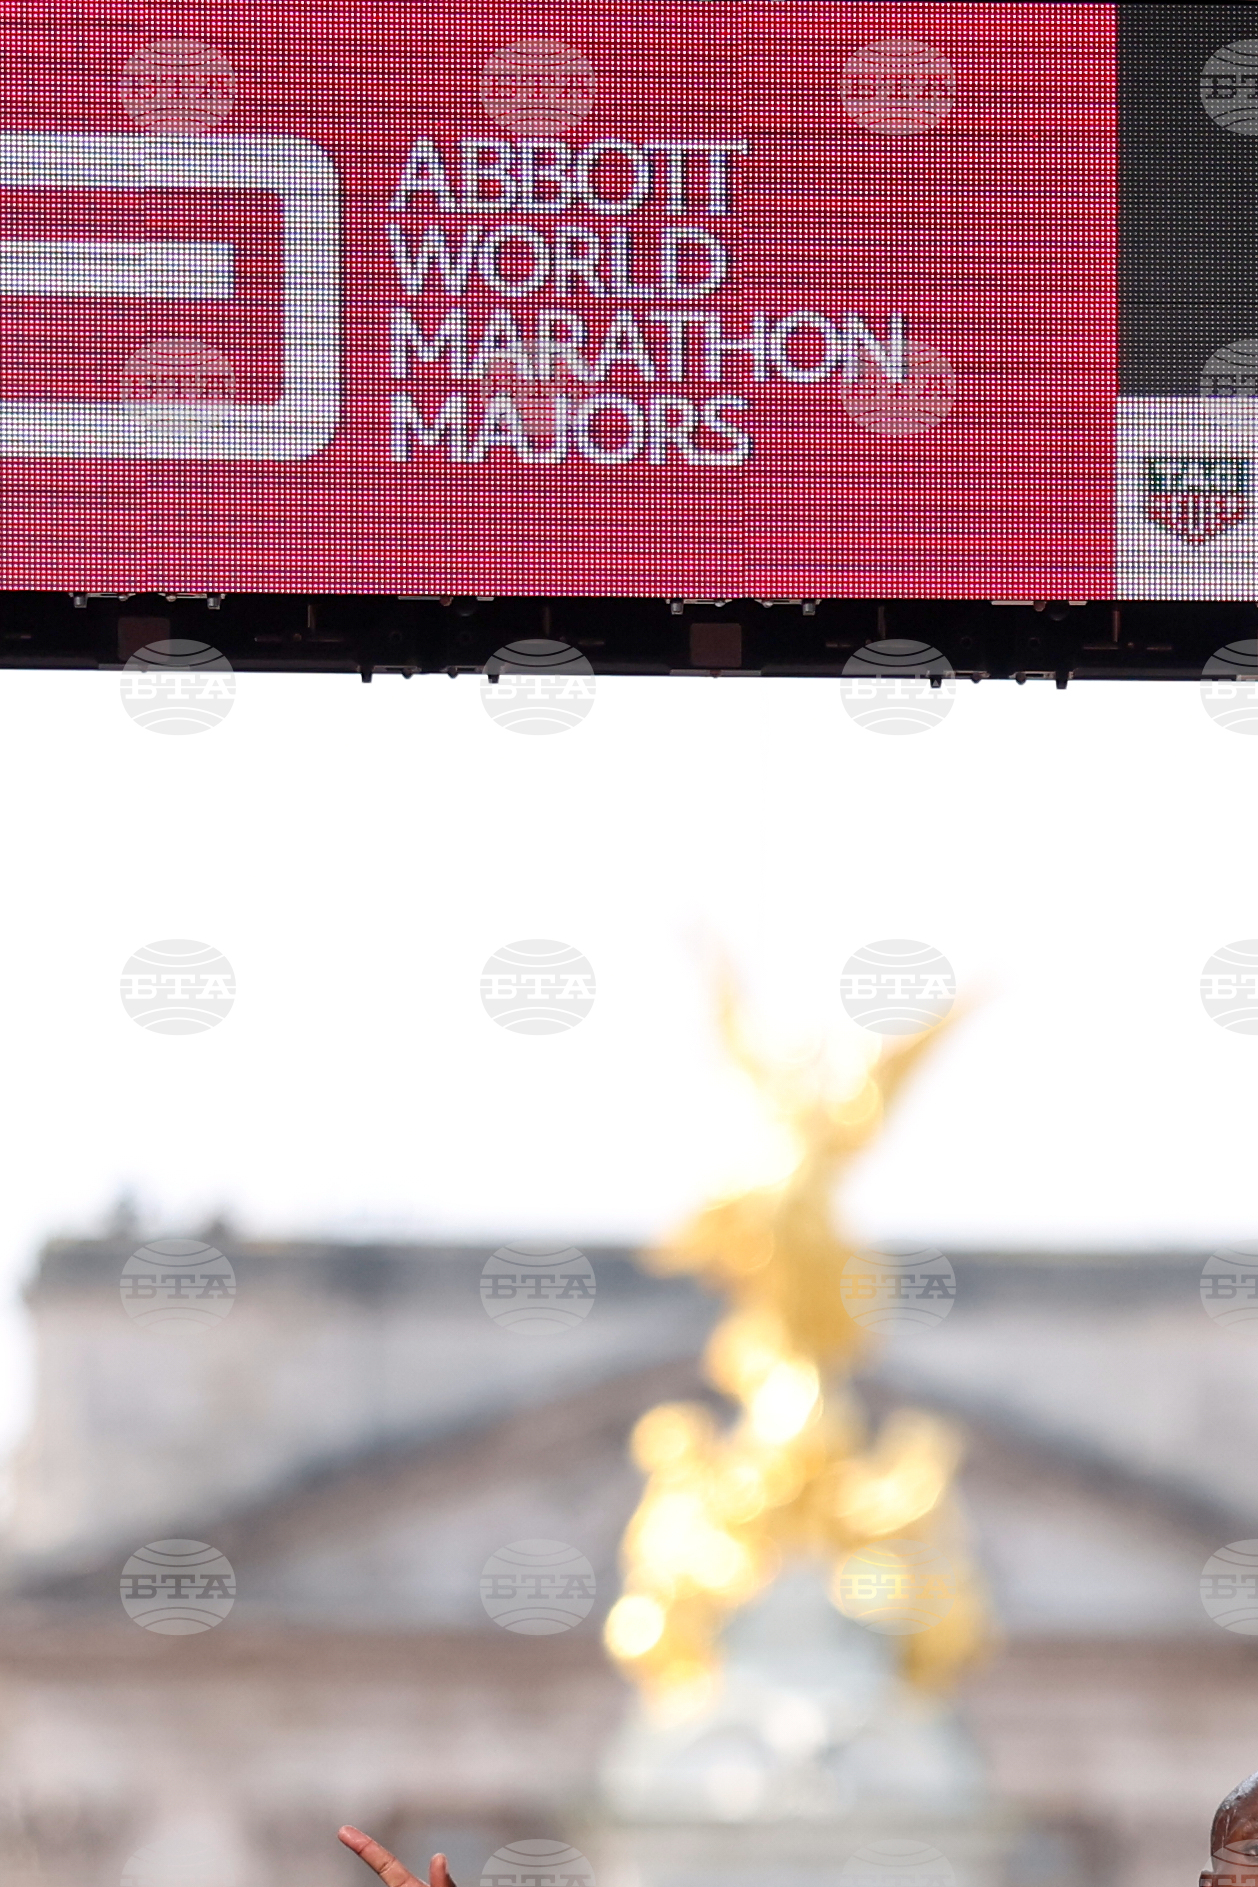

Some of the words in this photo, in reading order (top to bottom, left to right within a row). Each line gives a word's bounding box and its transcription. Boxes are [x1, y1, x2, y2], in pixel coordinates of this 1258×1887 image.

[391, 138, 748, 216] ABBOTT
[389, 225, 727, 300] WORLD
[389, 308, 909, 386] MARATHON
[389, 392, 751, 467] MAJORS
